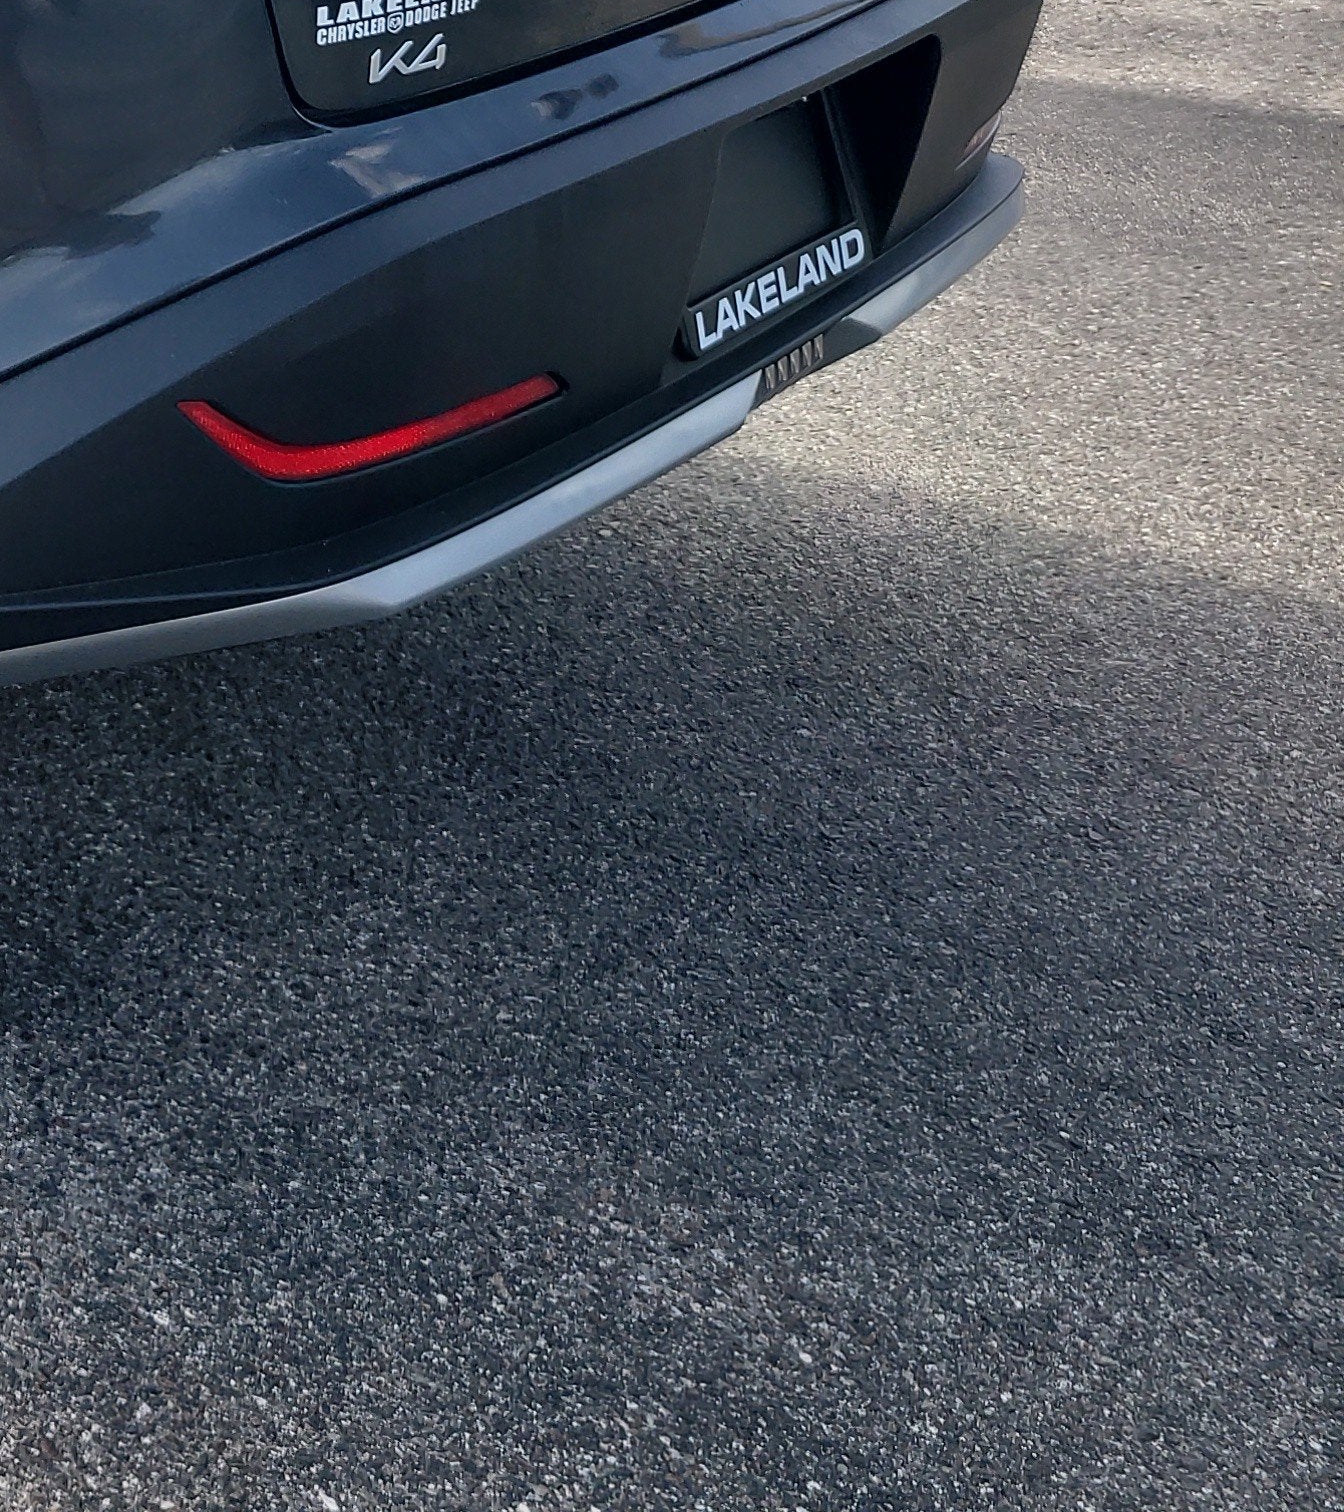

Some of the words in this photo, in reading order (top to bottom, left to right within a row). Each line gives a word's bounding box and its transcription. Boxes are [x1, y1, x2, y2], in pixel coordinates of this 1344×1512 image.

[316, 16, 386, 46] CHRYSLER
[405, 0, 447, 28] DODGE
[368, 33, 447, 84] K4
[694, 228, 866, 352] LAKELAND
